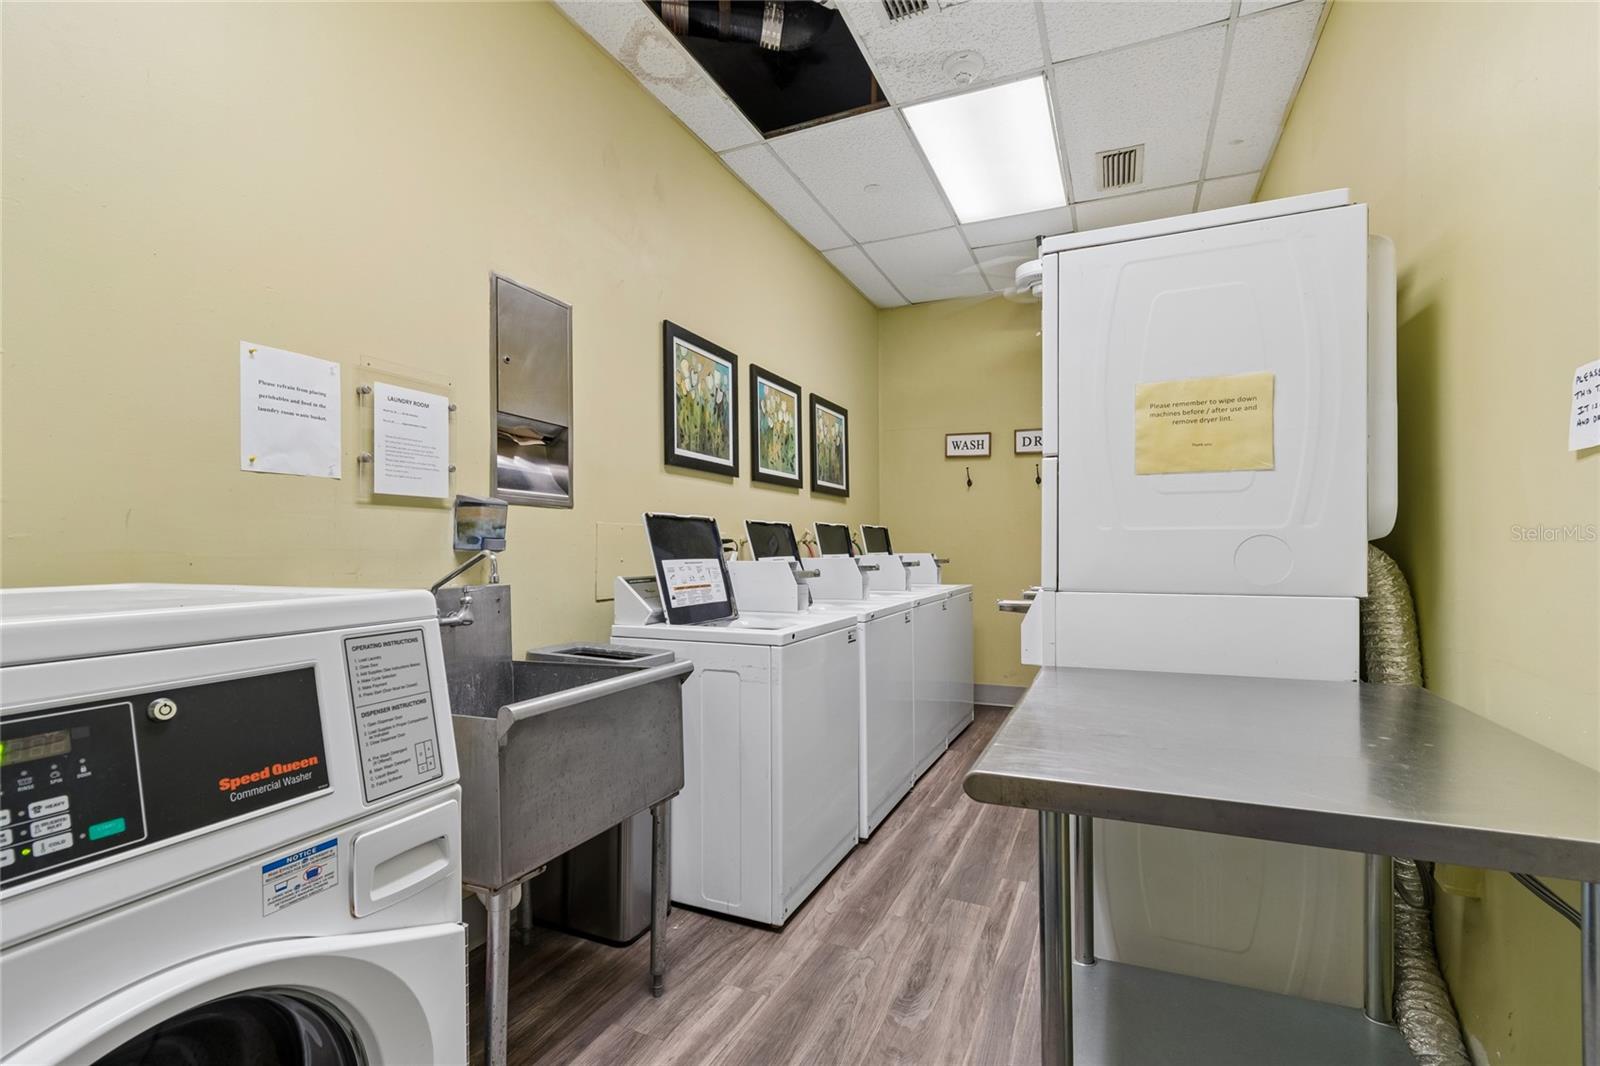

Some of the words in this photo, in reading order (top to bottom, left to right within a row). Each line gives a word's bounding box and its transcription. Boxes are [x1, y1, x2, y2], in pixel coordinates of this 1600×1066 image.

[1576, 368, 1600, 385] PLEAS
[387, 396, 412, 406] LAUNDRY
[413, 400, 430, 409] ROOM
[1172, 400, 1208, 408] remember
[258, 406, 279, 414] laundry
[1150, 410, 1181, 418] machines
[1182, 408, 1205, 416] before
[952, 440, 984, 450] WASH
[1022, 436, 1043, 448] DR
[351, 641, 382, 651] OPERATING
[382, 636, 418, 646] INSTRUCTIONS
[360, 706, 390, 718] DISPENSER
[391, 697, 426, 710] INSTRUCTIONS
[219, 767, 270, 790] Speed
[272, 756, 318, 776] Queen
[230, 780, 280, 802] Commercial
[282, 771, 312, 787] Washer
[286, 848, 318, 864] NOTICE
